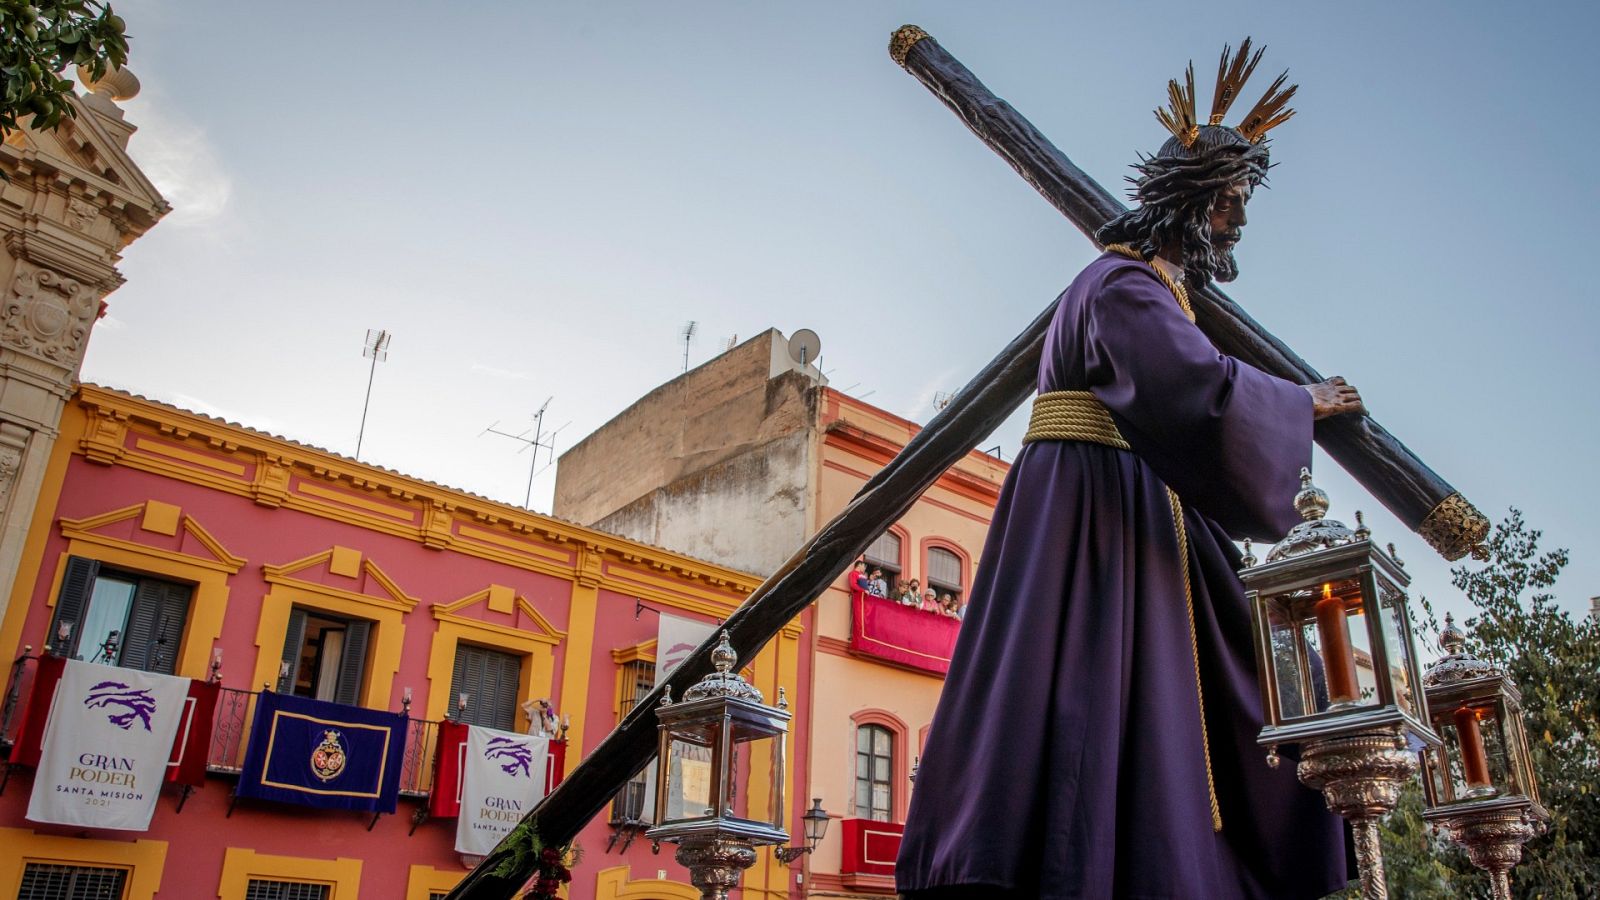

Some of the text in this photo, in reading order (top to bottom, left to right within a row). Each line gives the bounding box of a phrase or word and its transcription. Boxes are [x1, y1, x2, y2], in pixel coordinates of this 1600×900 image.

[79, 752, 135, 771] GRAN
[70, 766, 136, 789] PODER
[56, 785, 94, 795] SANTA
[85, 797, 110, 807] 2021
[485, 796, 523, 811] GRAN
[473, 822, 497, 831] SANTA
